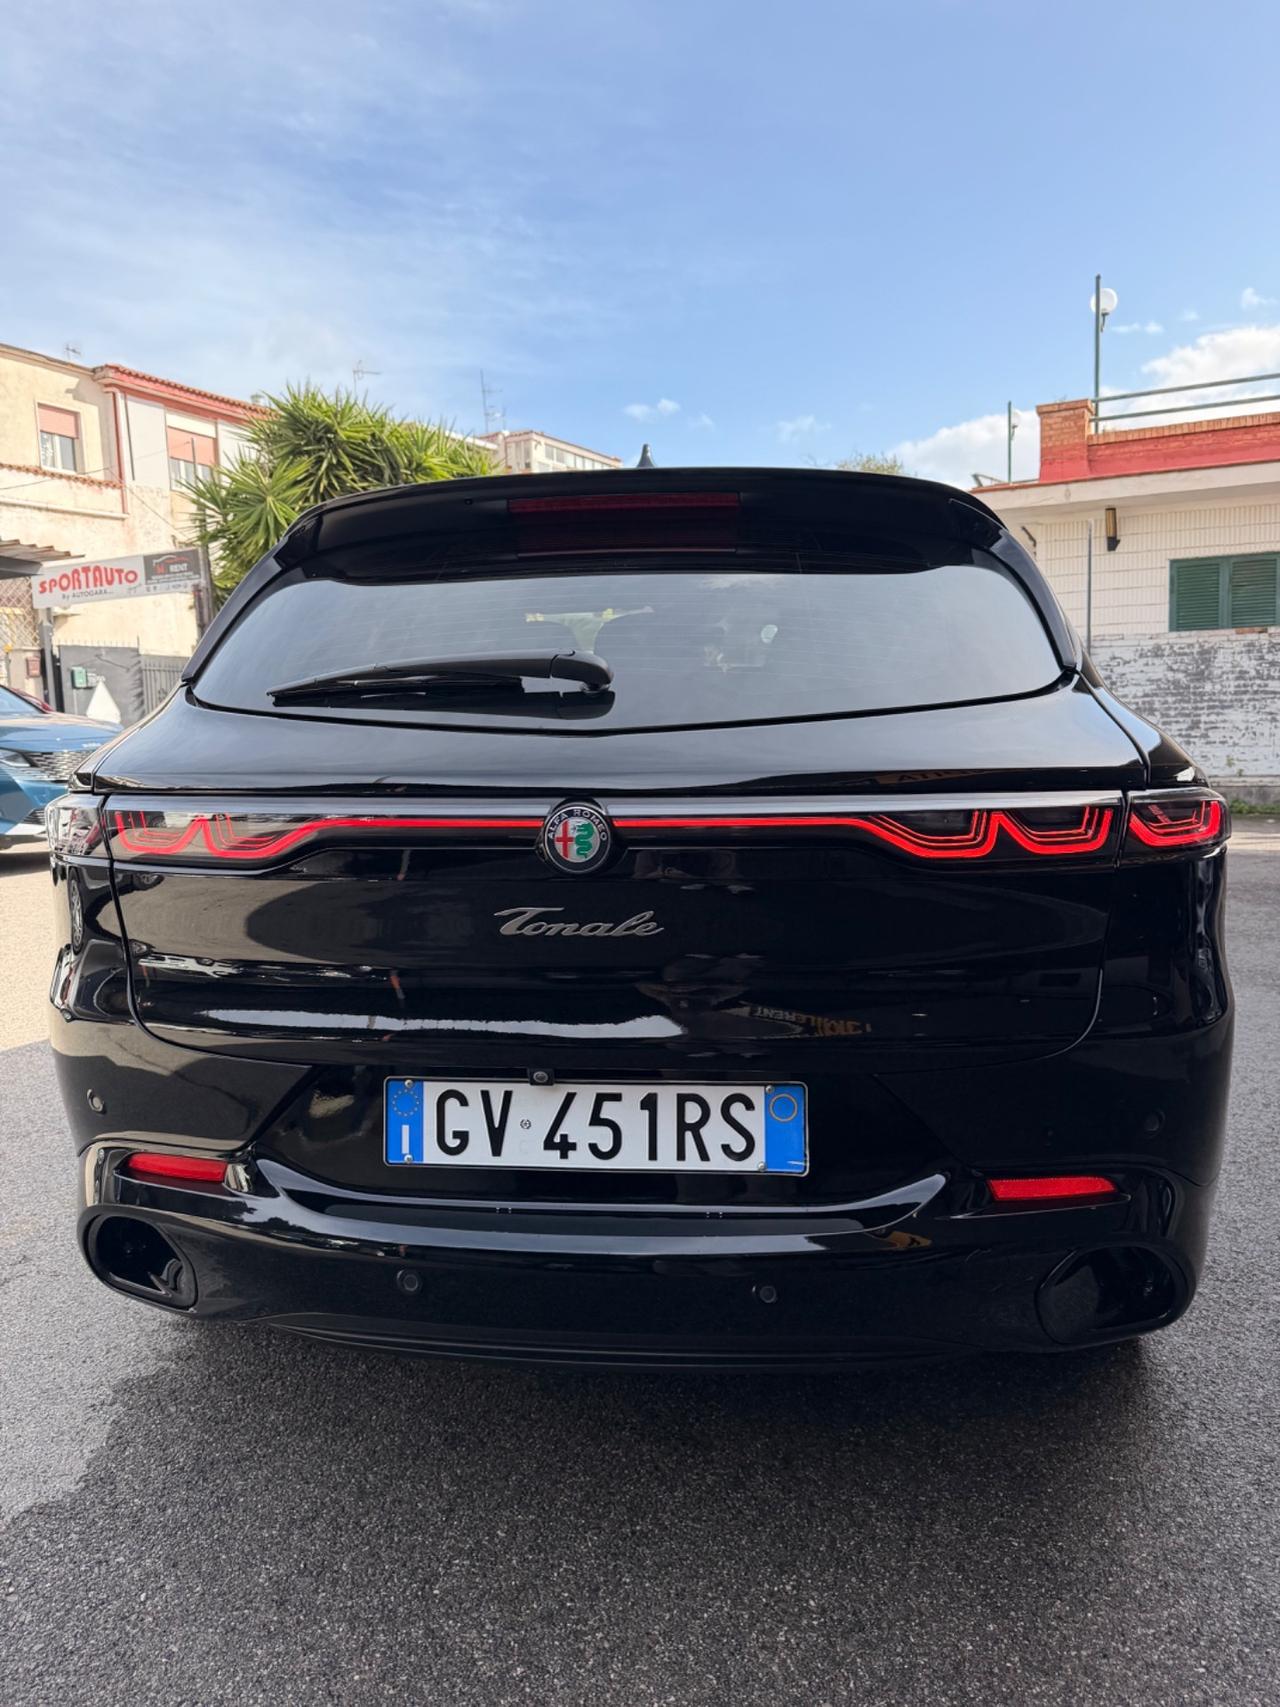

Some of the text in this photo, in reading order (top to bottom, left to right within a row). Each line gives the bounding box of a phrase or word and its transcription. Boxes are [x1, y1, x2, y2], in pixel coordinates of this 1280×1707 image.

[38, 565, 139, 595] SPORTAUTO
[548, 809, 608, 841] ALFA ROMEO
[493, 907, 665, 937] Tonale
[436, 1089, 756, 1163] GV 451RS
